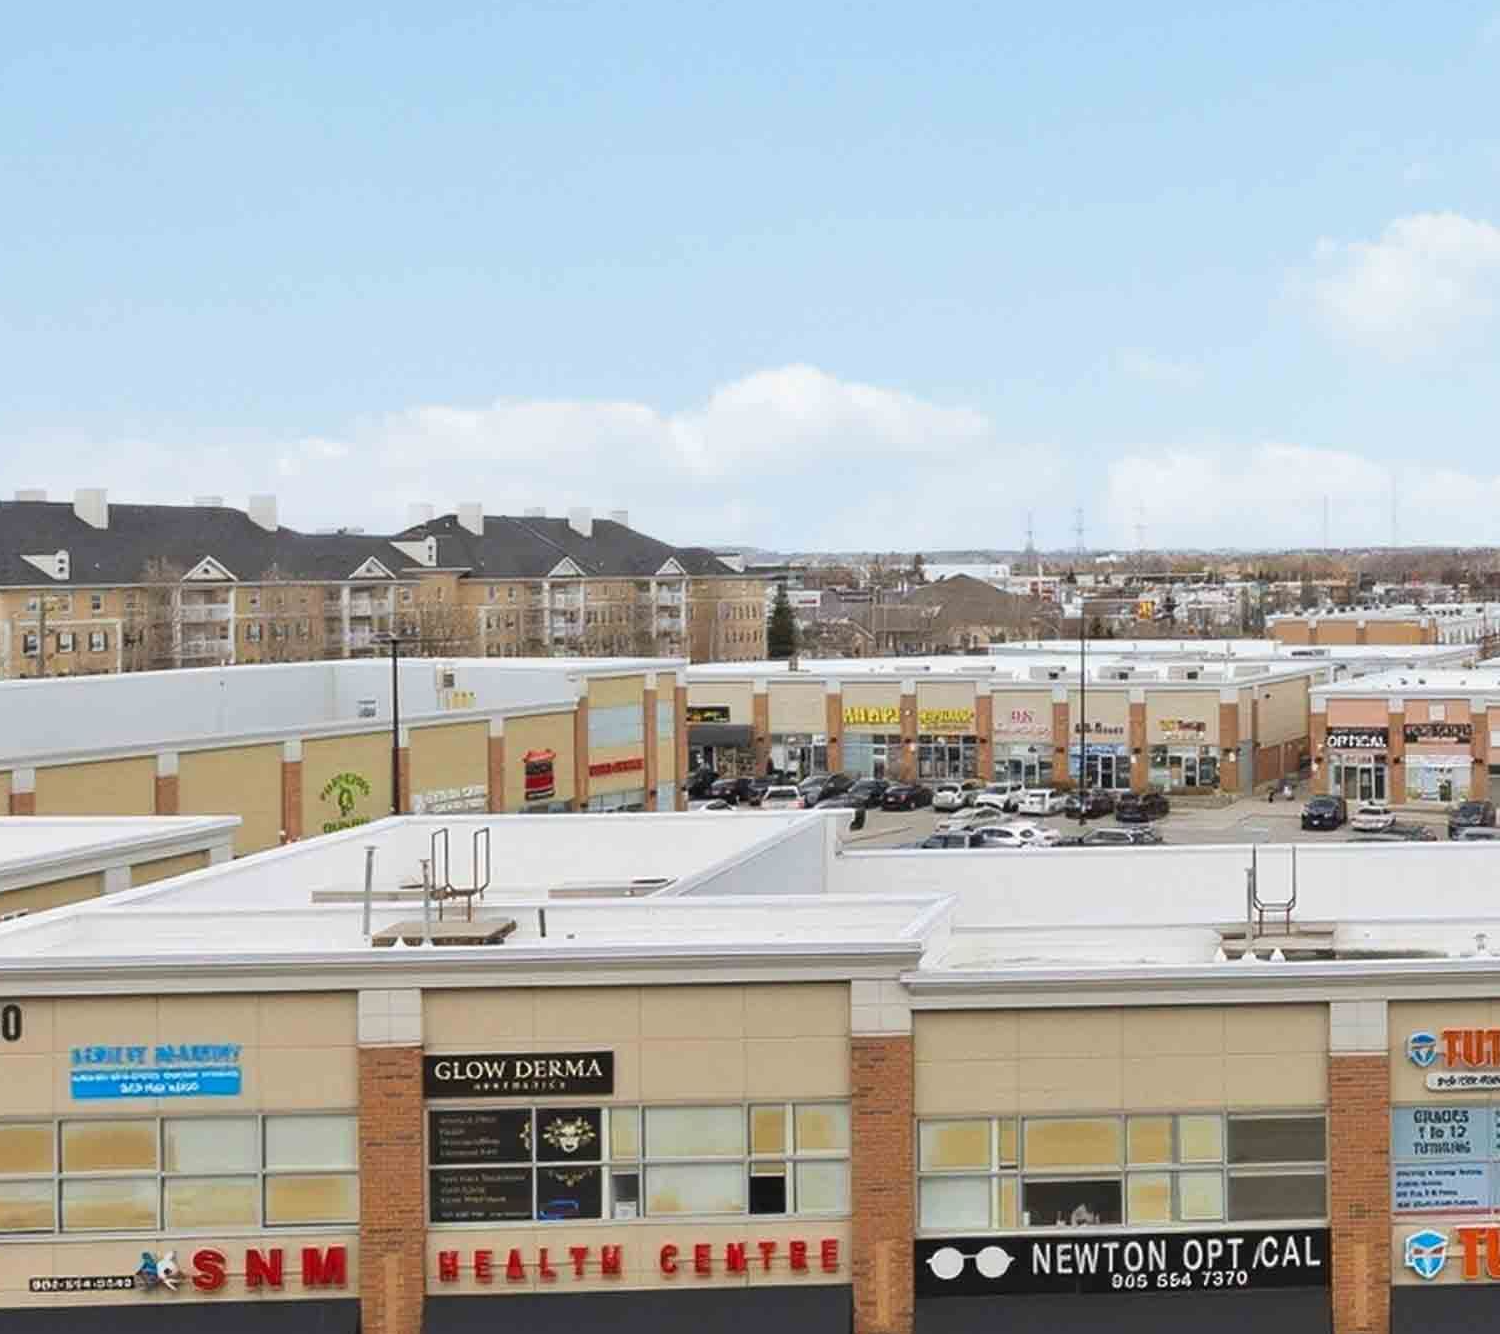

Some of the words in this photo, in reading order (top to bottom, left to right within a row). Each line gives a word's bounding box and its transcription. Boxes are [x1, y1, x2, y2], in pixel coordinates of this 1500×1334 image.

[434, 1060, 506, 1080] GLOW
[515, 1058, 603, 1078] DERMA
[190, 1245, 348, 1291] SNM
[438, 1245, 624, 1284] HEALTH
[660, 1238, 840, 1276] CENTRE
[1032, 1239, 1167, 1276] NEWTON
[1183, 1235, 1322, 1270] OPTICAL
[1111, 1272, 1149, 1289] 905
[1201, 1269, 1248, 1287] 7370
